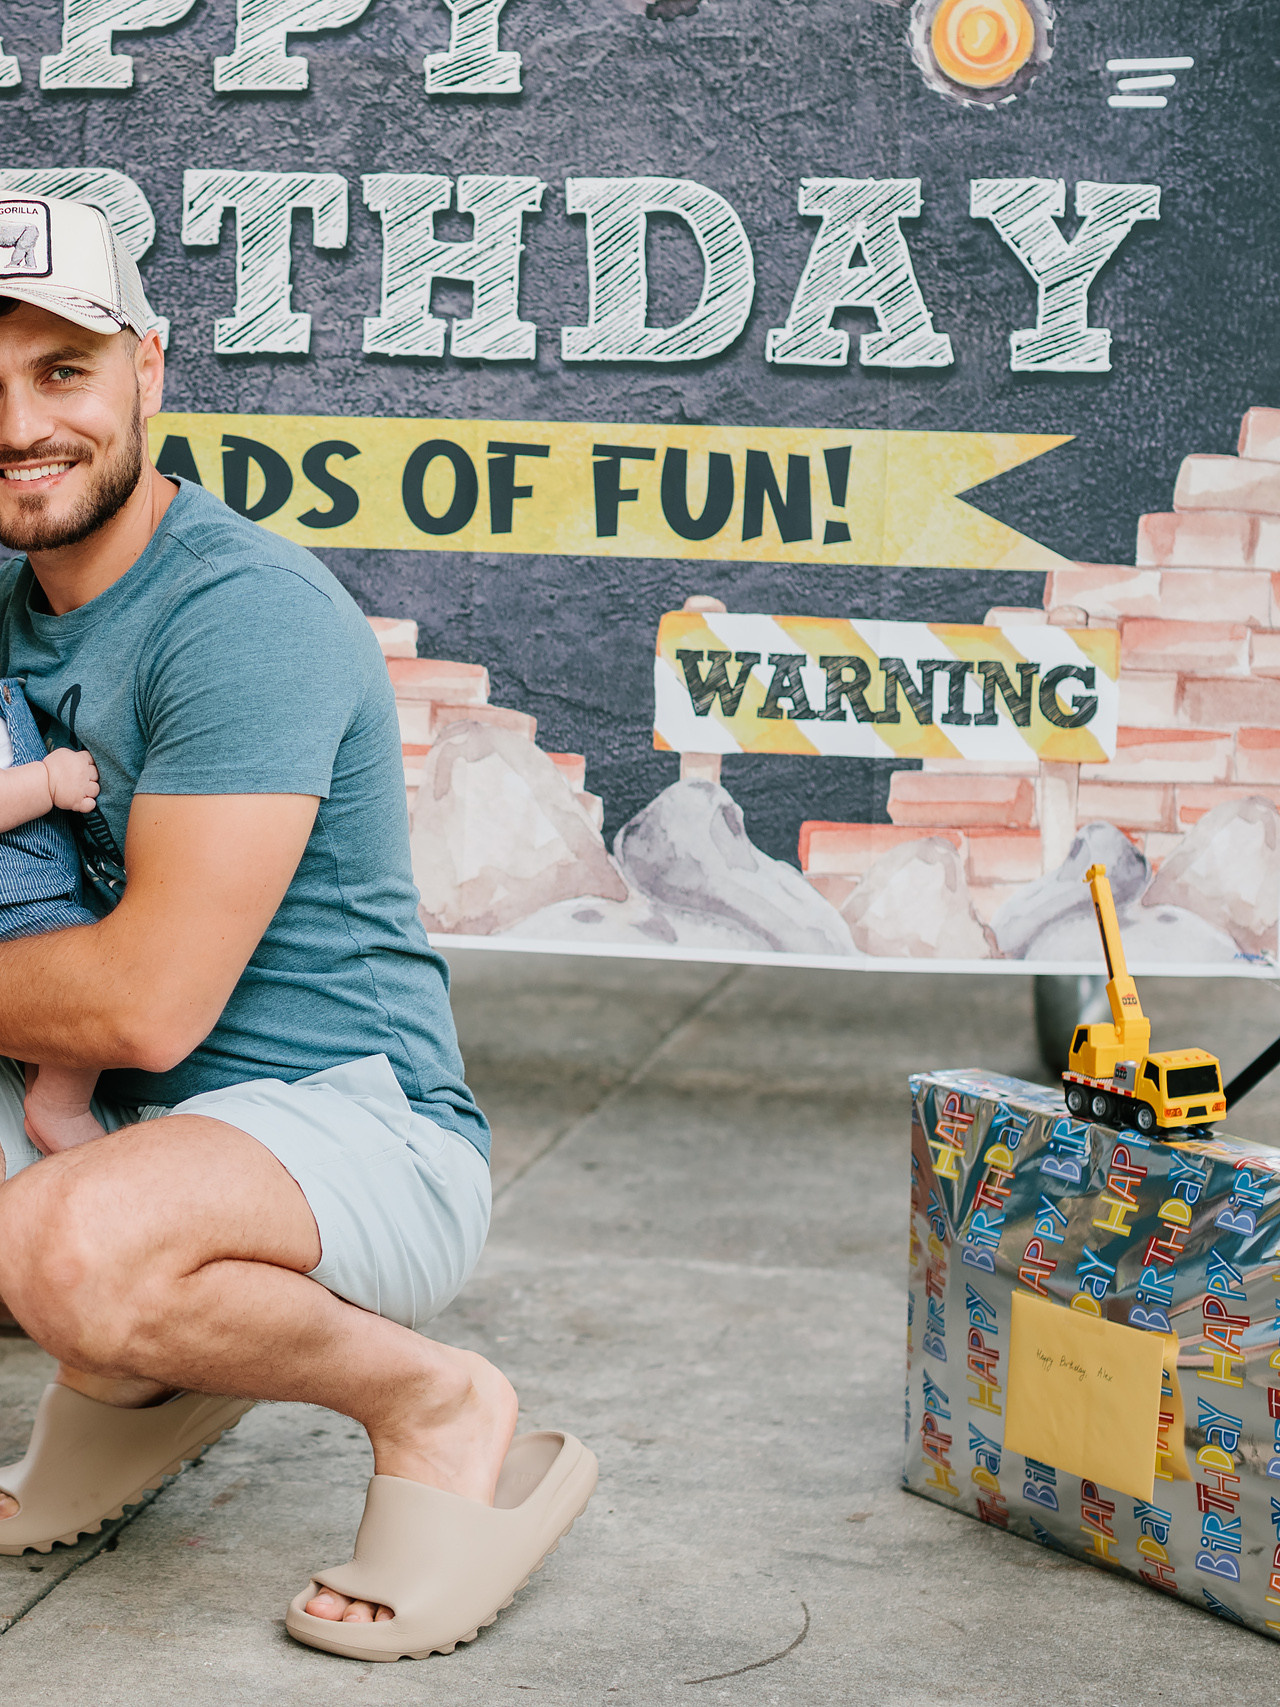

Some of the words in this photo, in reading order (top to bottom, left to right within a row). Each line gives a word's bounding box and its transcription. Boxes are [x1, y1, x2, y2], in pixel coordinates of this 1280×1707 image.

[401, 438, 551, 537] OF
[592, 441, 853, 546] FUN!
[676, 649, 1100, 730] WARNING
[1016, 1192, 1069, 1303] APPY
[966, 1282, 1003, 1417] HAPPY
[1197, 1246, 1251, 1389] HAPPY
